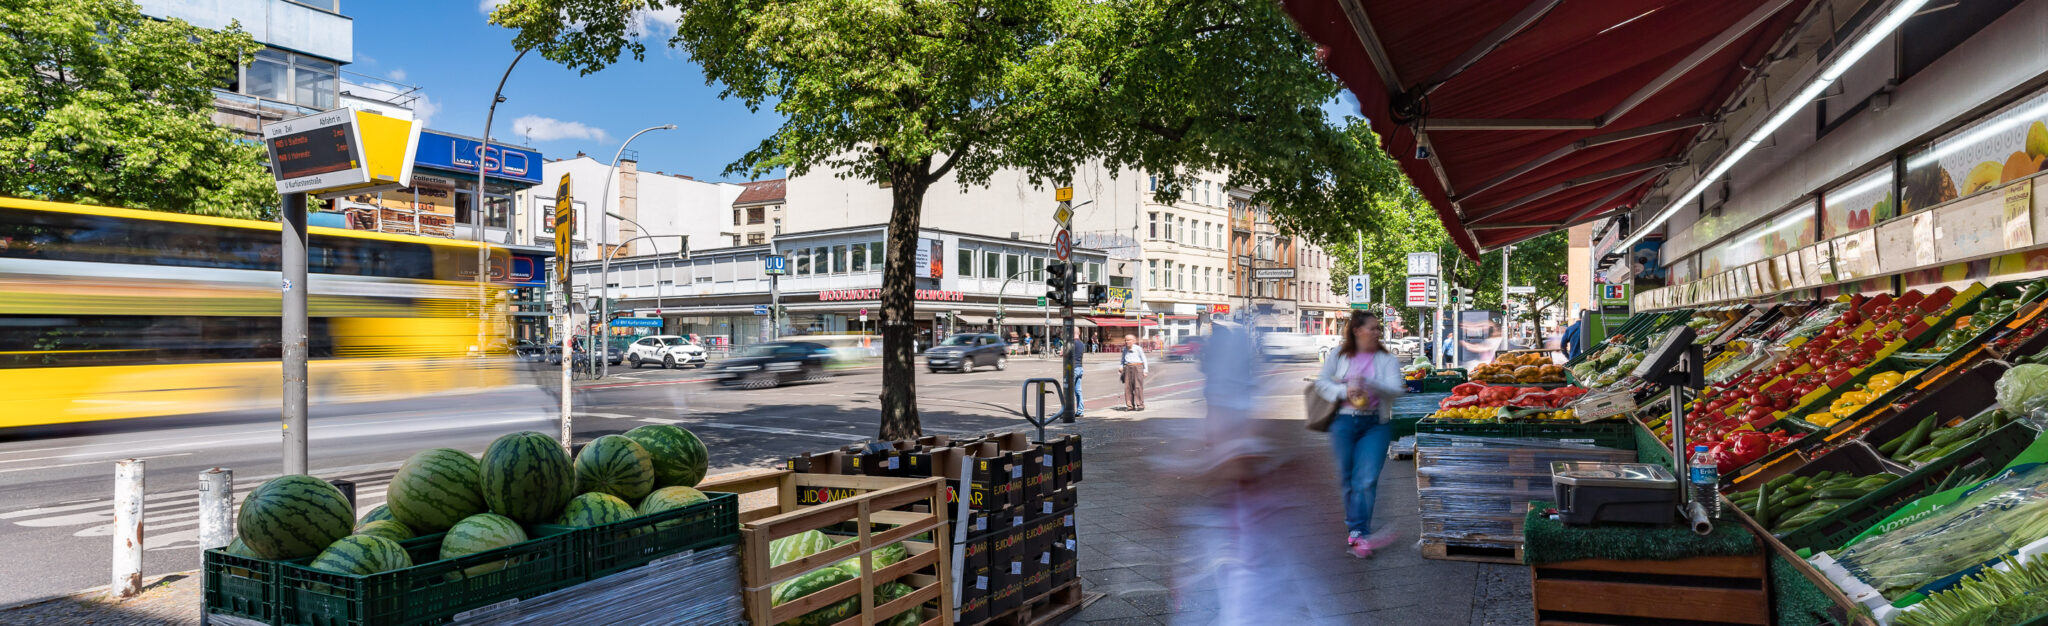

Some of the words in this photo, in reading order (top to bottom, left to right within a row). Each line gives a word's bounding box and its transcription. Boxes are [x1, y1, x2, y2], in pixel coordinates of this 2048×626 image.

[452, 140, 528, 176] LSD
[413, 175, 446, 184] Collection
[766, 257, 773, 269] U
[775, 257, 783, 269] U
[915, 289, 964, 302] OLWORTH
[994, 480, 1022, 495] EJIDOMAR
[799, 487, 857, 504] JIDOMAR
